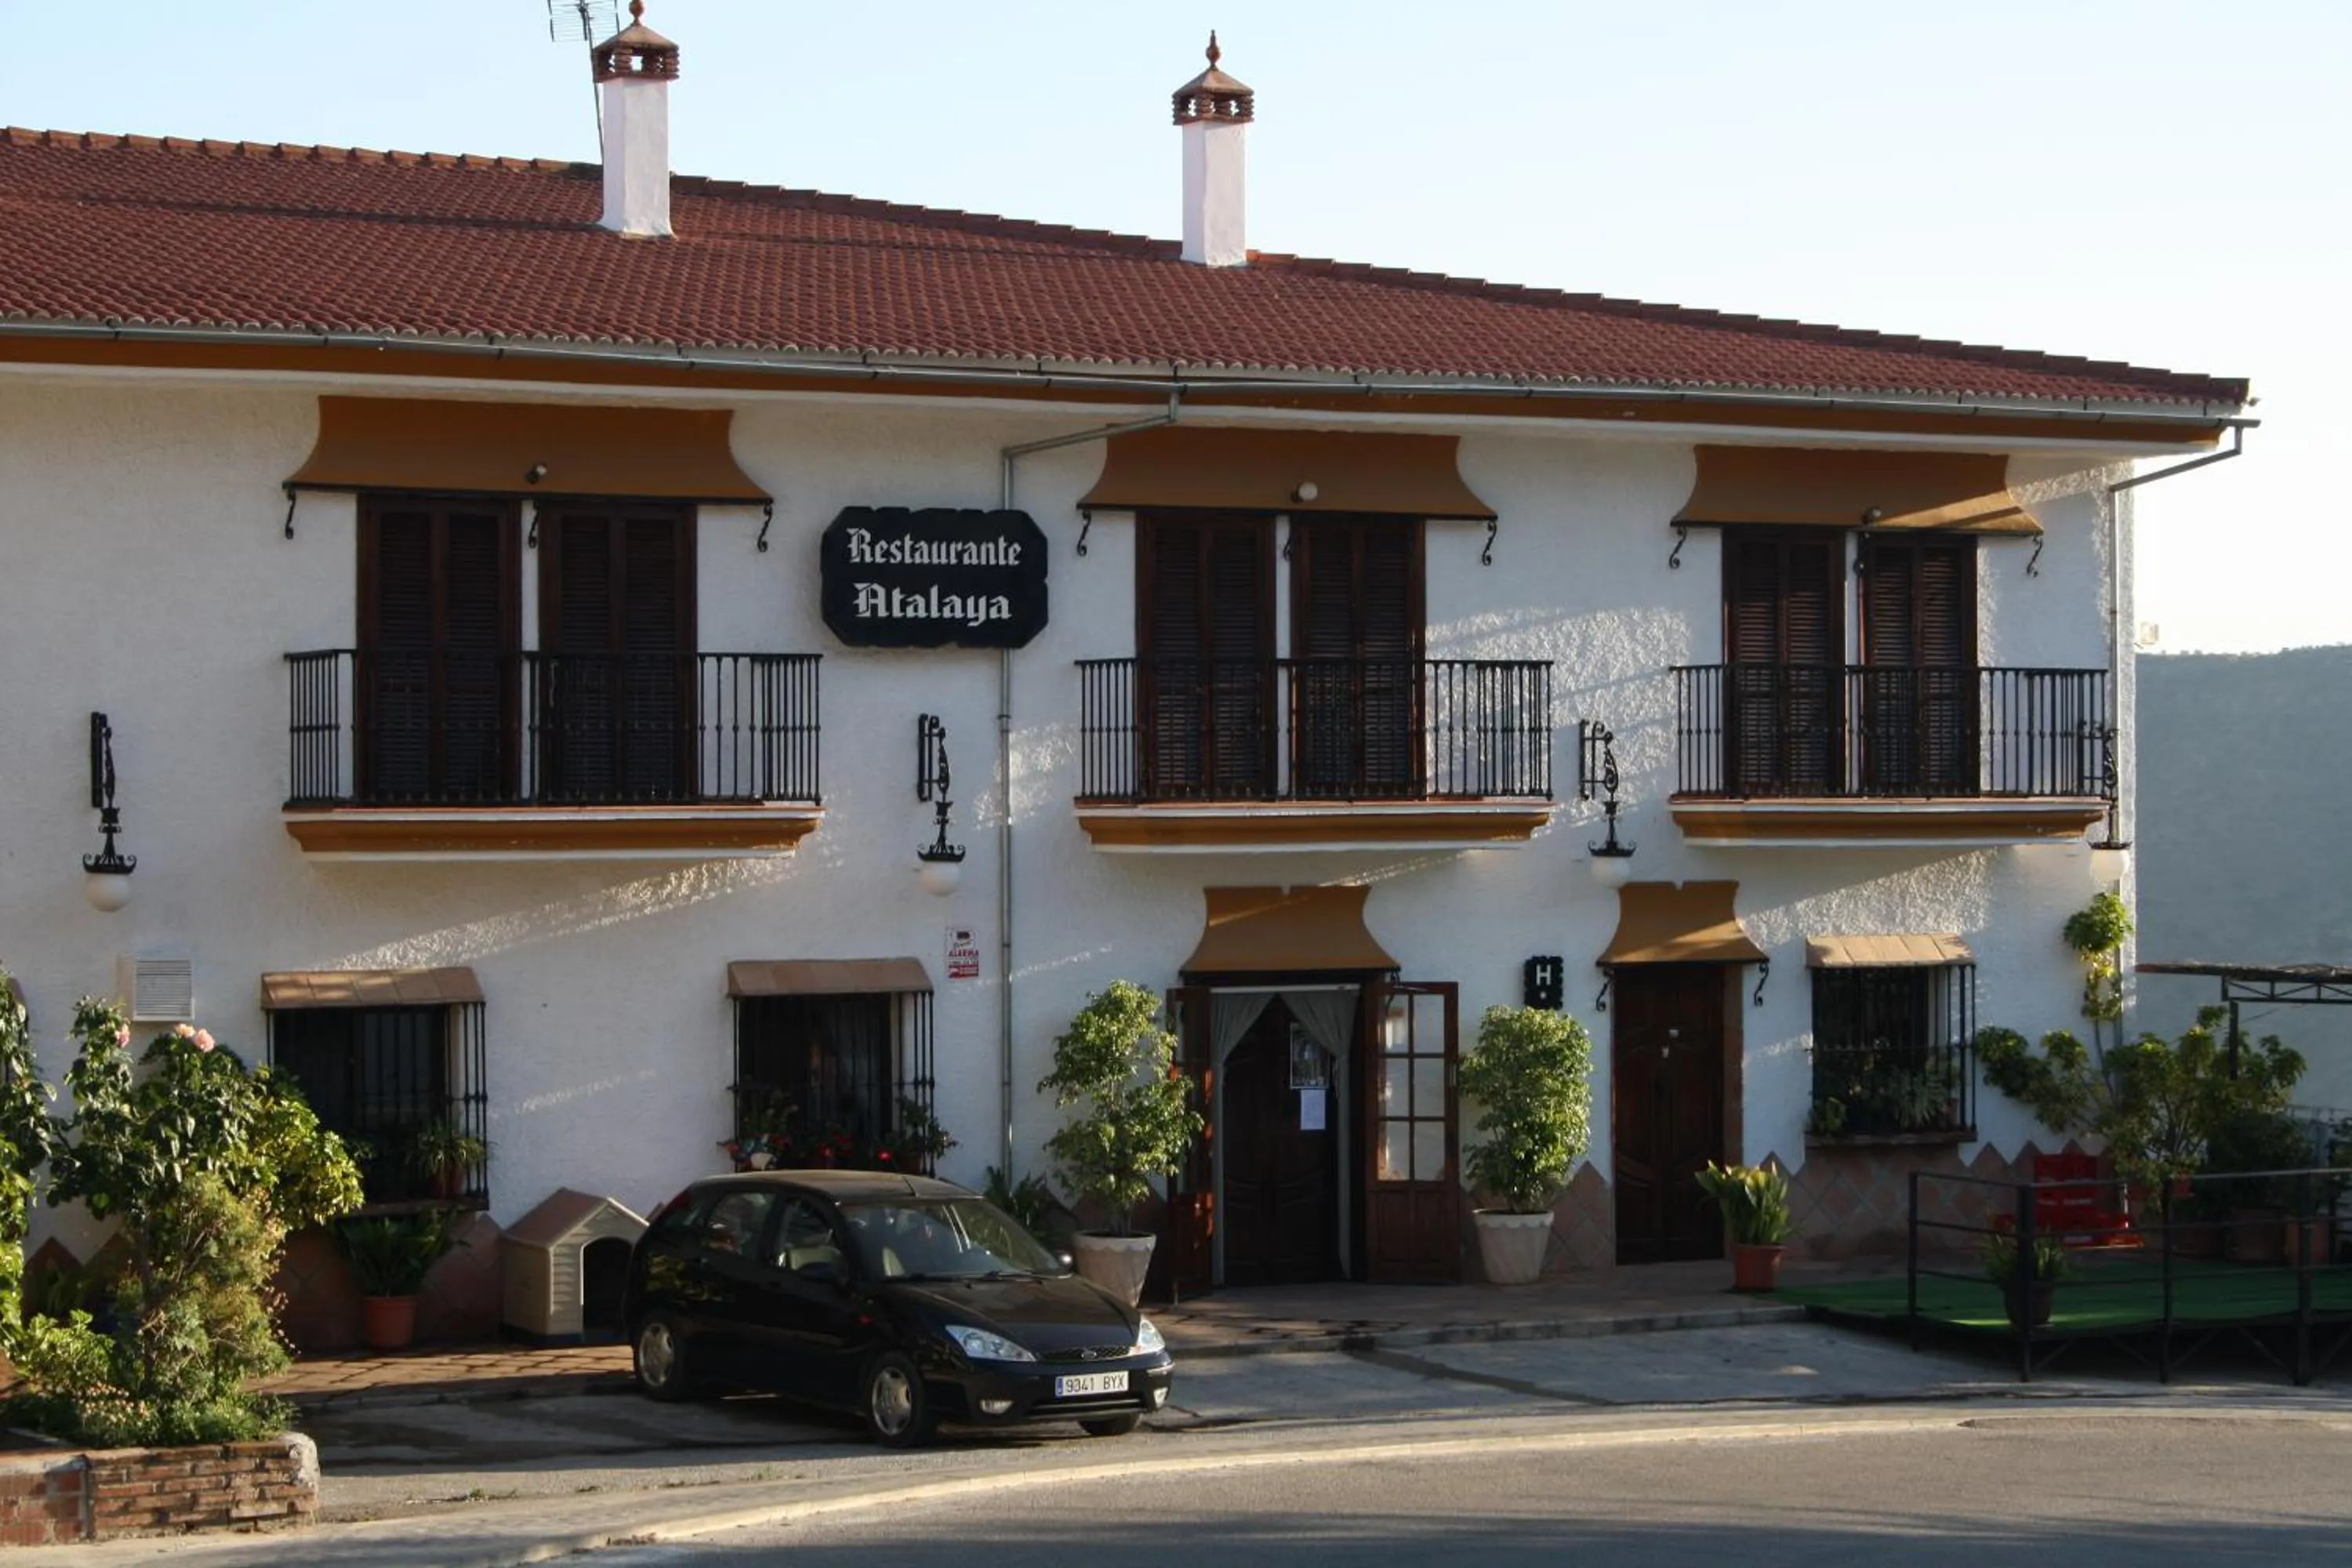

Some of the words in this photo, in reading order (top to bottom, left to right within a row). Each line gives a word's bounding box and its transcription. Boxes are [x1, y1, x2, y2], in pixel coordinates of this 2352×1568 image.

[846, 528, 1022, 565] Restaurante
[853, 583, 1012, 627] Atalaya
[1537, 964, 1552, 985] H
